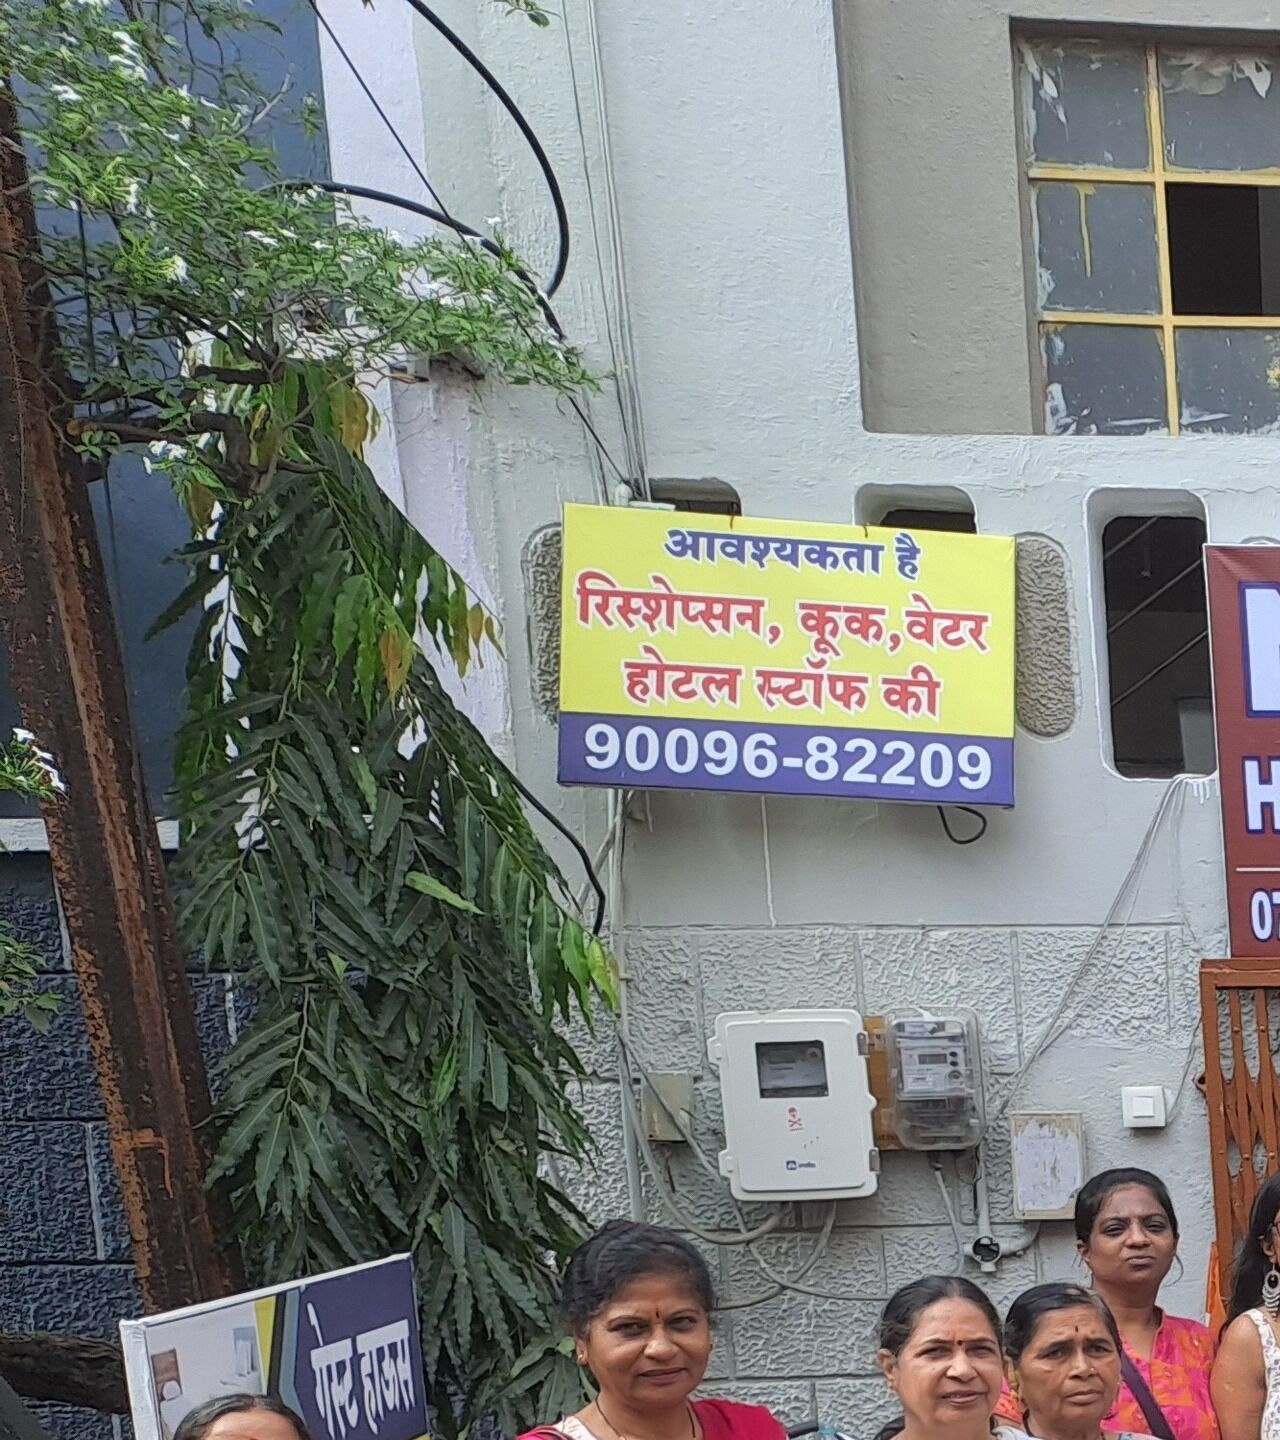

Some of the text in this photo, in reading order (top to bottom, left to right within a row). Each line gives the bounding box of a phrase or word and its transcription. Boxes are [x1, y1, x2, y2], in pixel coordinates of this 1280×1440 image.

[665, 529, 920, 580] आवश्यकता है
[625, 645, 942, 718] होटल स्टॉफ की
[584, 724, 992, 790] 90096-82209
[307, 1302, 359, 1440] गेस्ट
